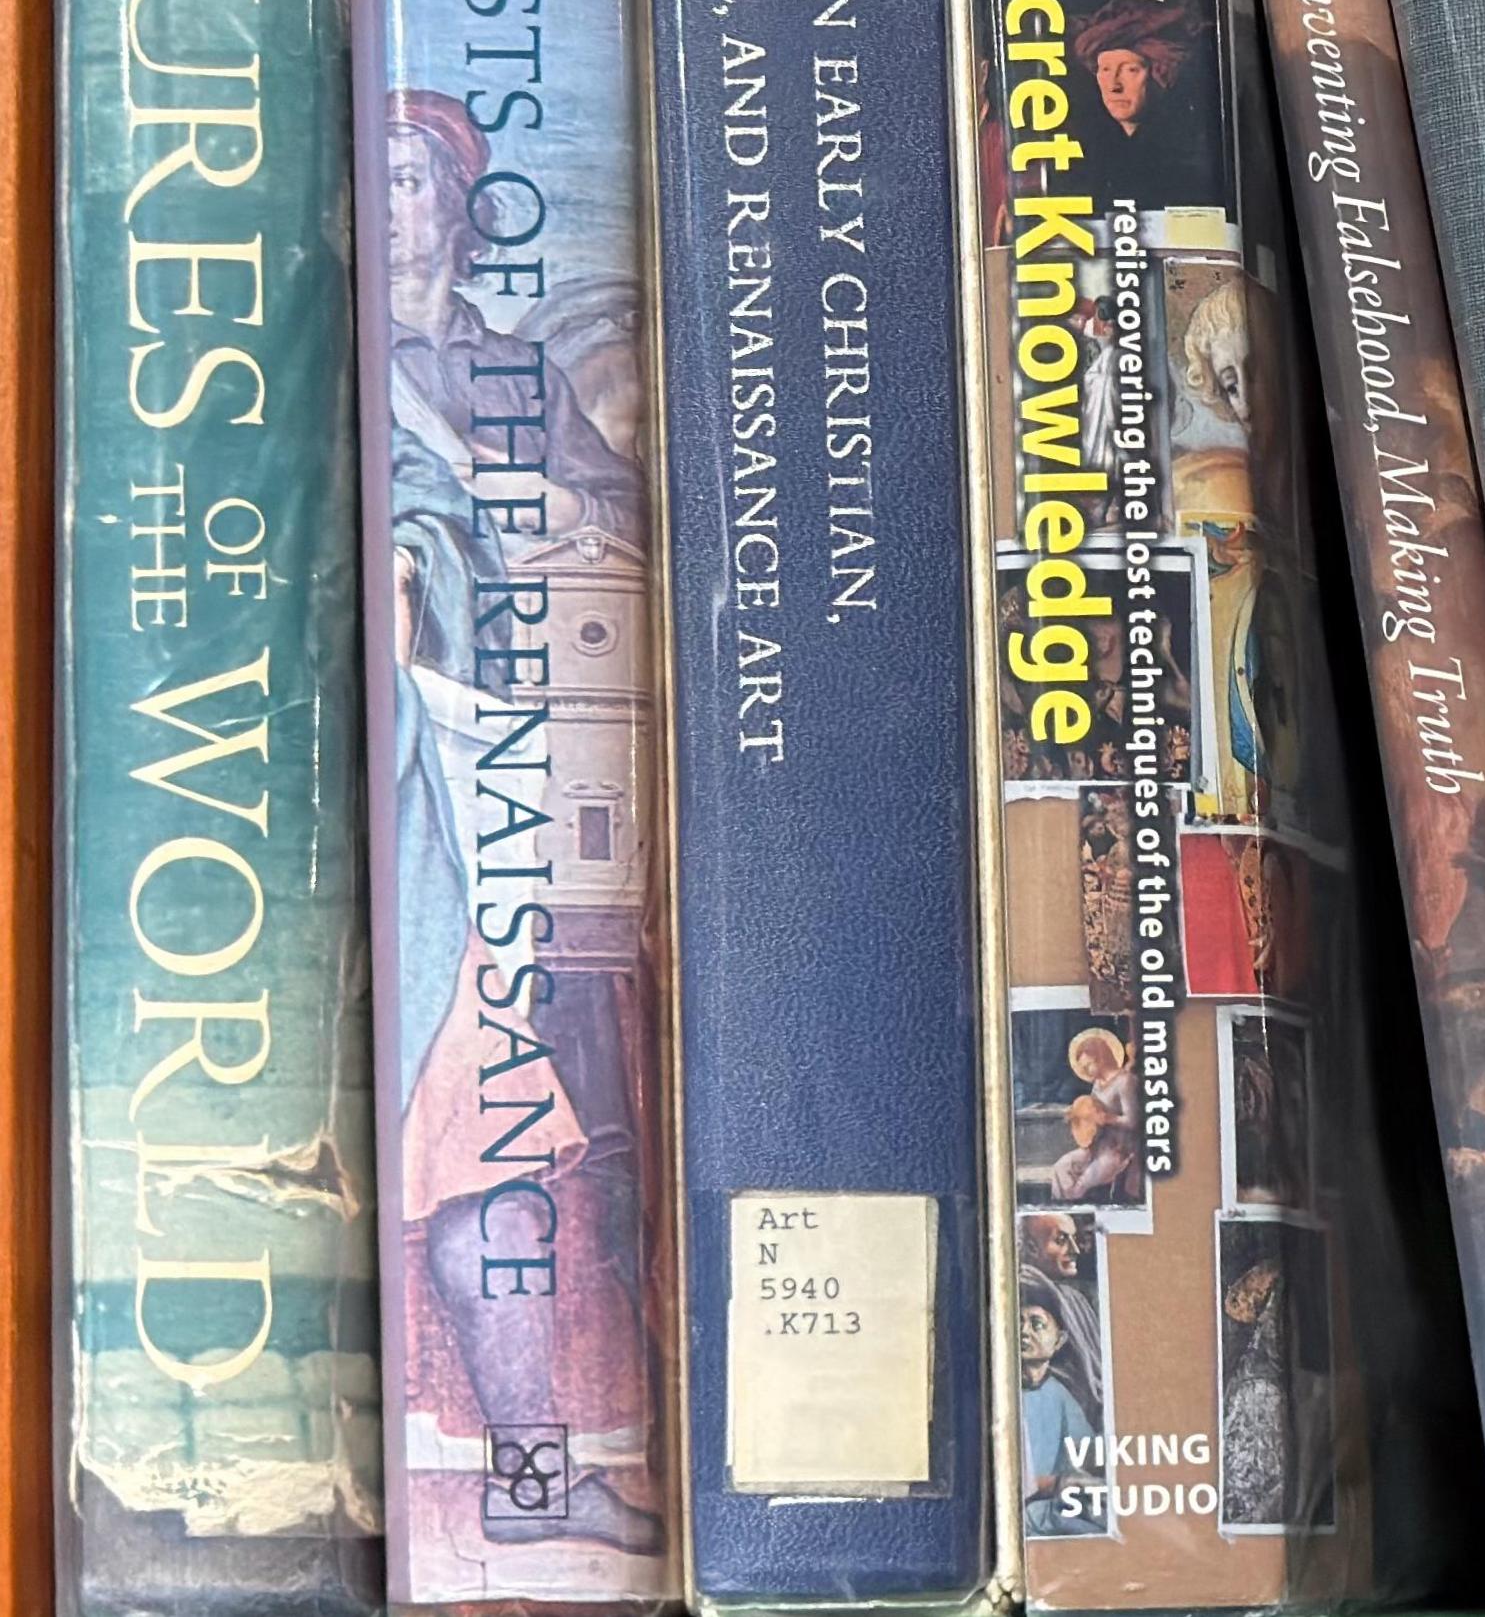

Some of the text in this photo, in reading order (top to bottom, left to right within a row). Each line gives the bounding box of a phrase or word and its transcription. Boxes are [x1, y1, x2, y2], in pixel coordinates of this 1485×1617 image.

[720, 32, 768, 171] AND
[813, 56, 866, 253] EARLY
[470, 169, 547, 300] OF
[1331, 183, 1427, 435] Falsehood,
[470, 341, 547, 541] THE
[725, 189, 780, 613] RENAISSANCE
[820, 271, 880, 624] CHRISTIAN,
[1008, 196, 1114, 745] Knowledge
[128, 463, 189, 632] THE
[204, 497, 268, 601] OF
[1369, 434, 1449, 643] Making
[737, 629, 785, 764] ART
[1112, 198, 1174, 1173] rediscovering the lost techniques of the old masters
[1407, 657, 1485, 795] Truth
[473, 575, 557, 1301] RENAISSANCE
[129, 646, 275, 1396] WORLD
[759, 1207, 820, 1232] Art
[759, 1243, 778, 1265] N
[759, 1277, 841, 1301] 5940
[764, 1312, 862, 1336] .K713
[1060, 1483, 1219, 1517] STUDIO
[1063, 1432, 1210, 1468] VIKING
